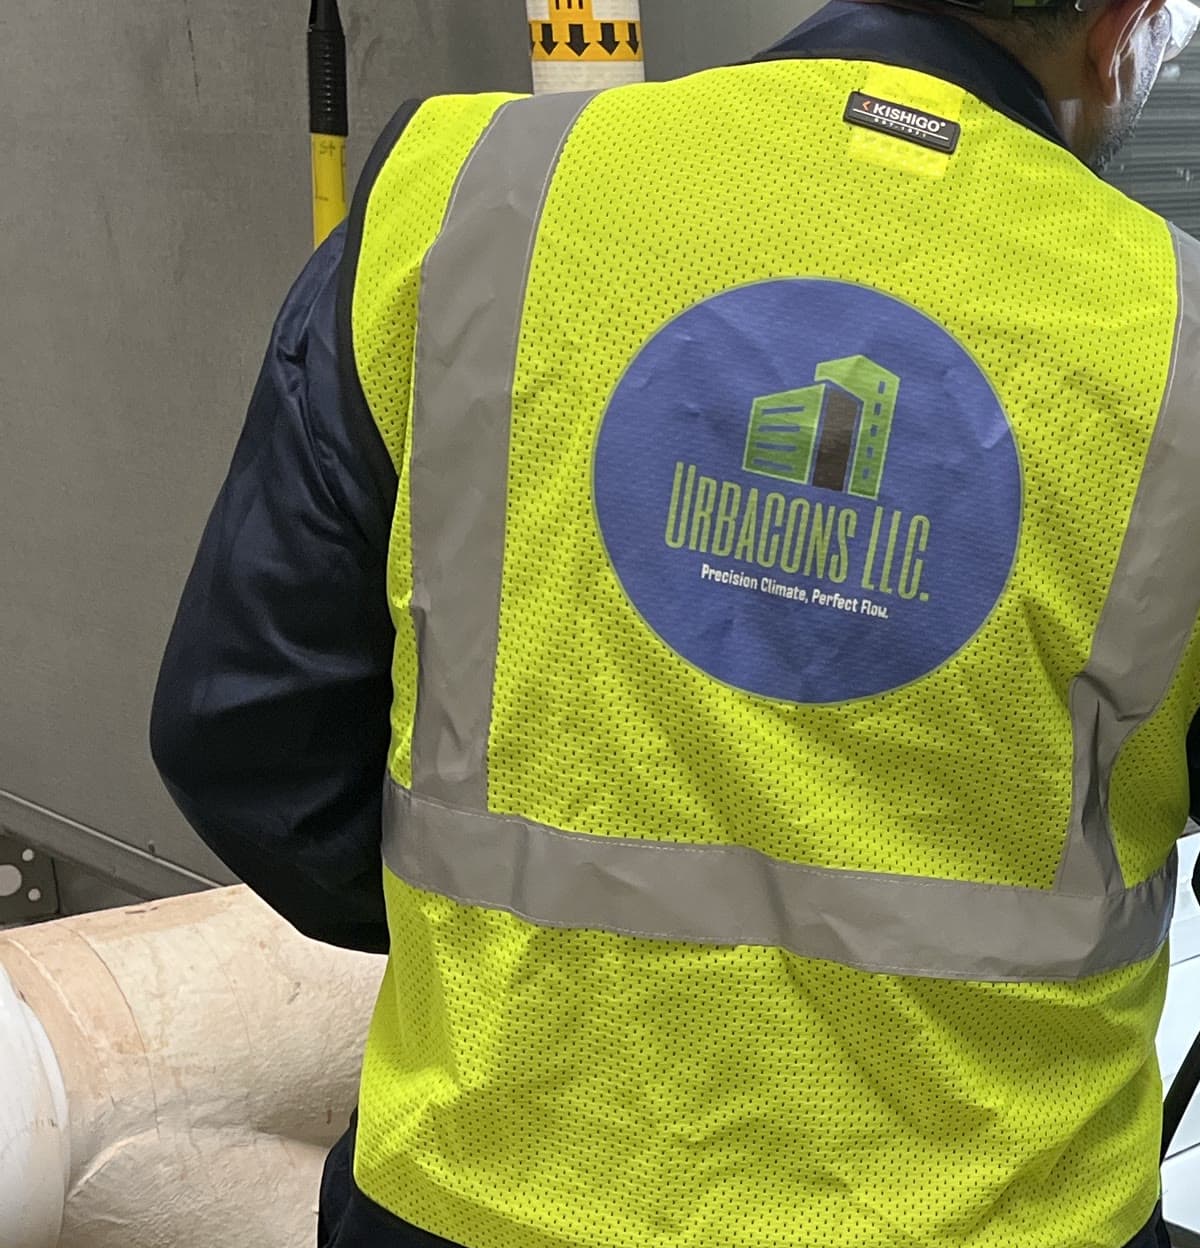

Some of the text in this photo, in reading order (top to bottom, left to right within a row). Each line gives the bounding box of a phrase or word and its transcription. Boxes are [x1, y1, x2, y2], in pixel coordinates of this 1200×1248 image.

[873, 103, 940, 132] KISHIGO
[665, 461, 930, 601] URBACONS LLC.
[701, 563, 889, 620] Precision Climate, Perfect Flow.
